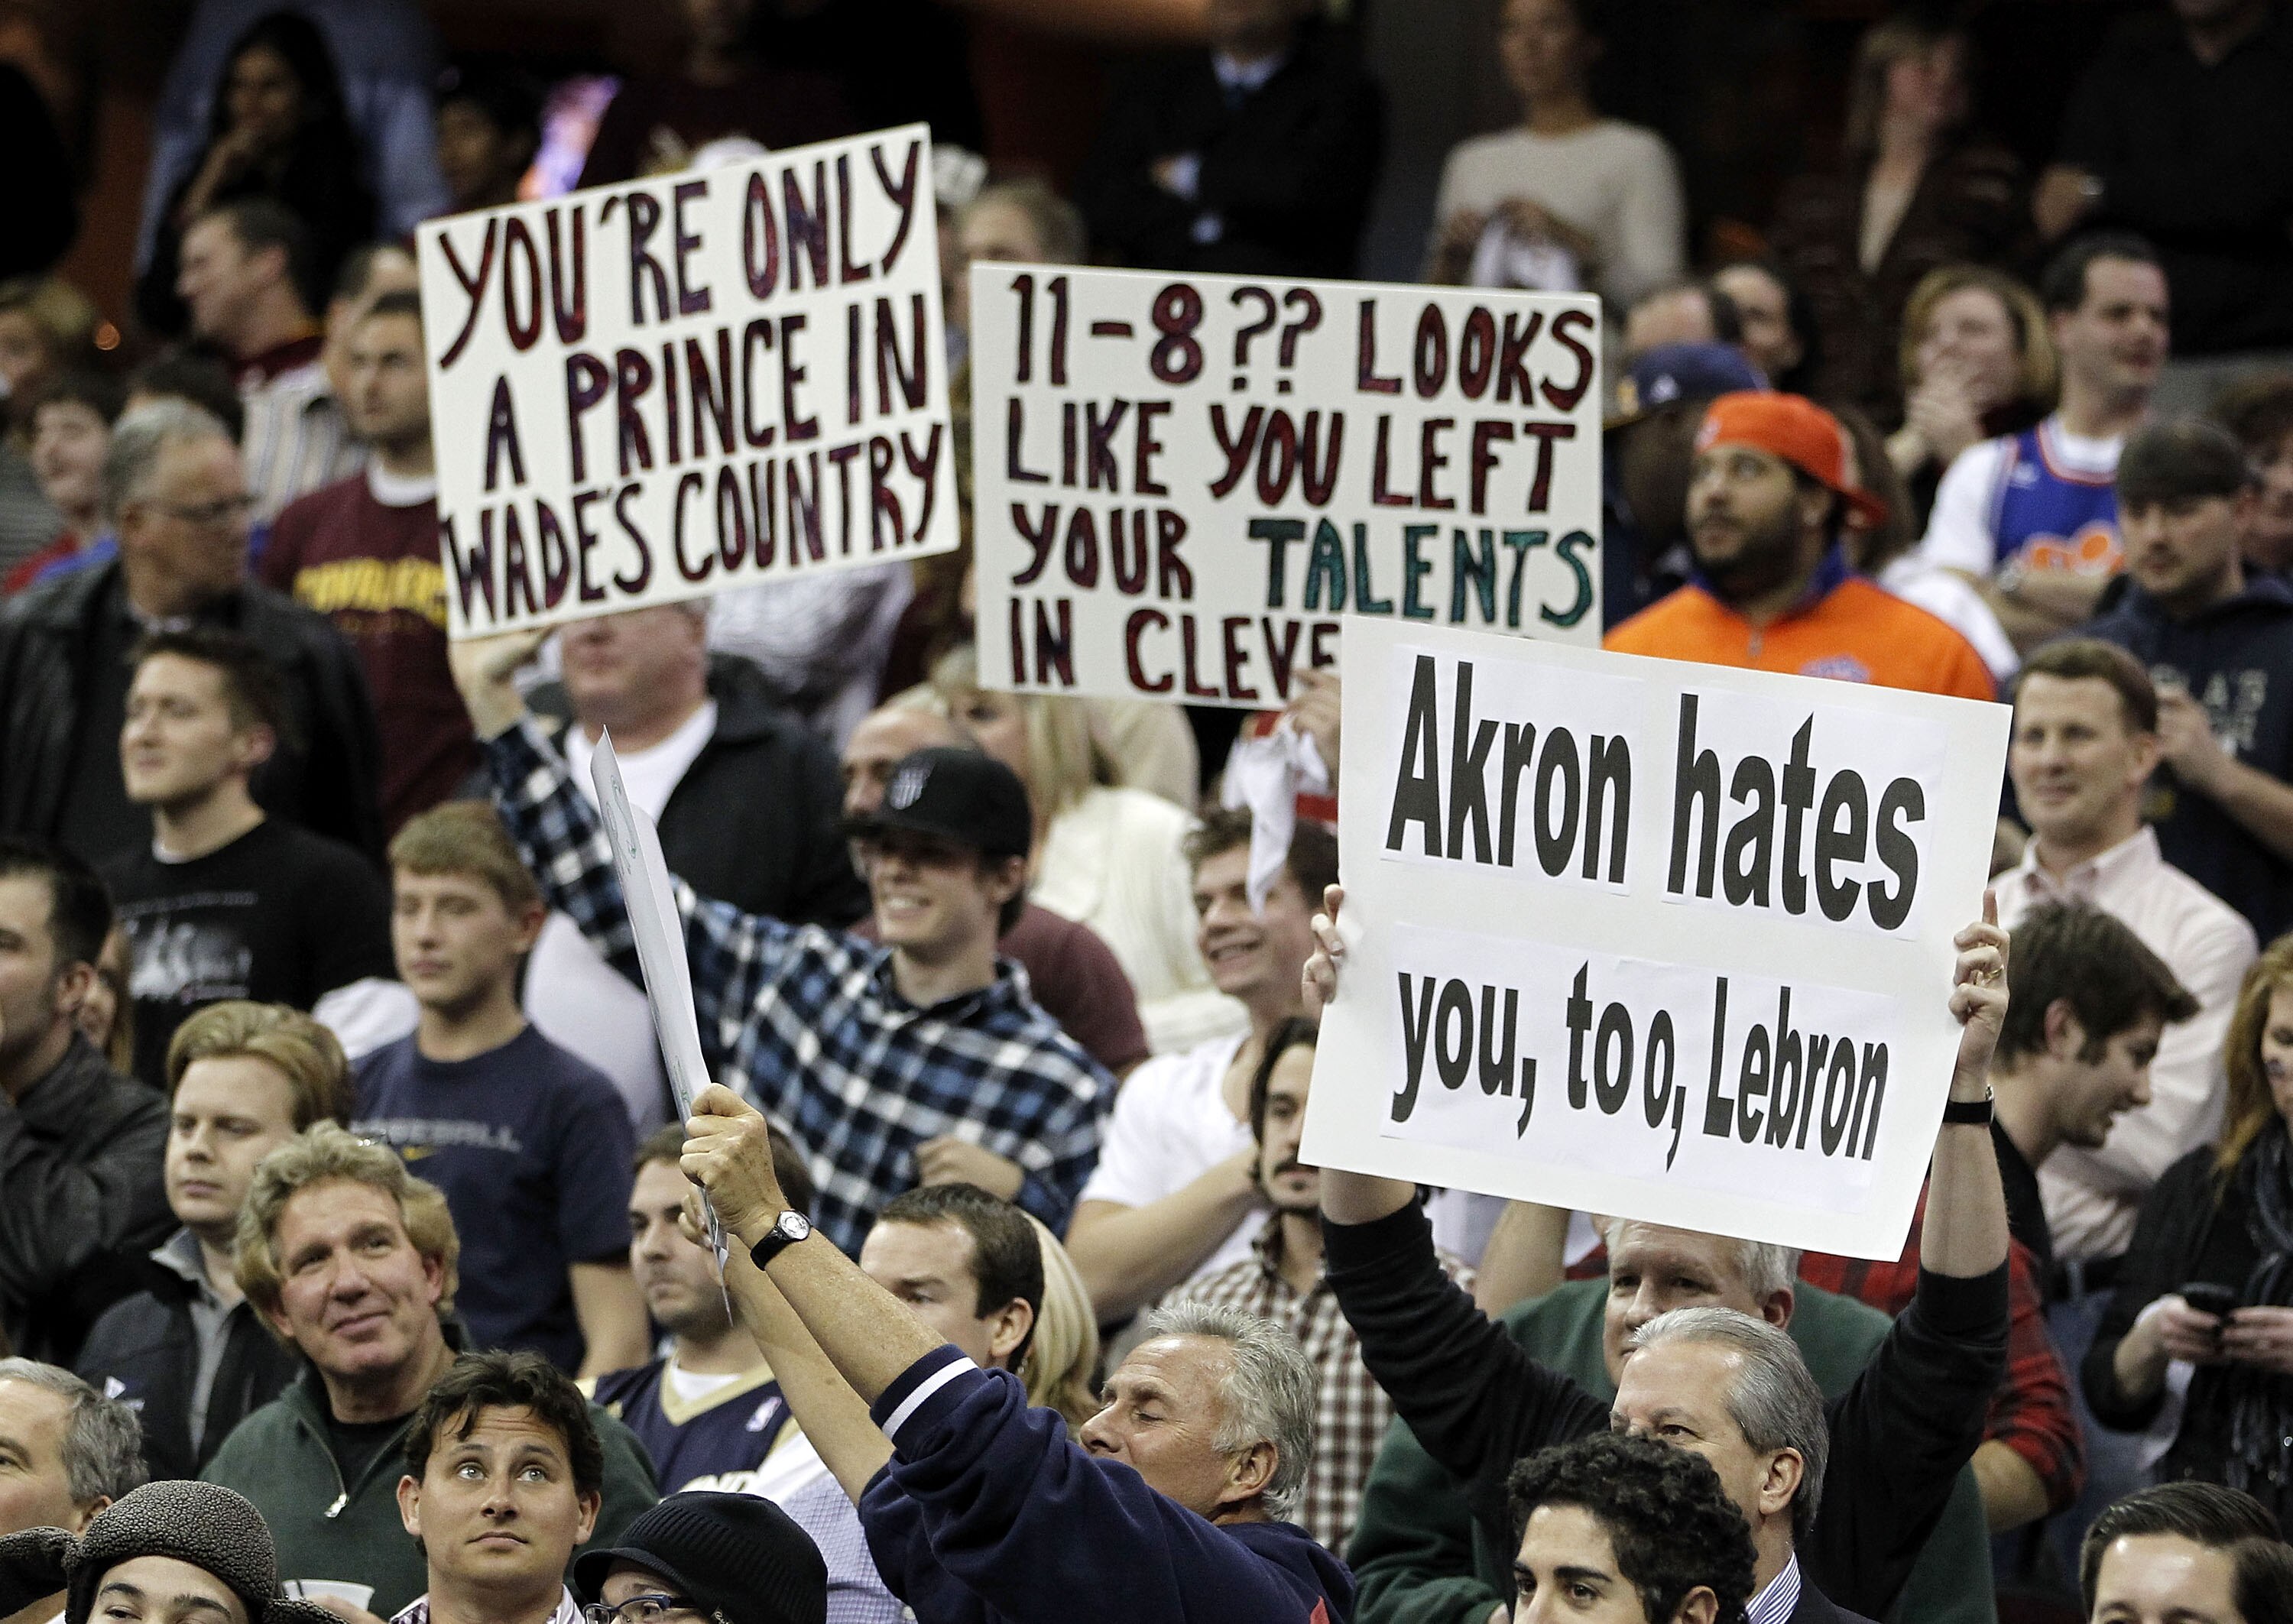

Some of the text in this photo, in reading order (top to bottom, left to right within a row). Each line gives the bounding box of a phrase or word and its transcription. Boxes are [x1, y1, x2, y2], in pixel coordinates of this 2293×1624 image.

[440, 141, 921, 368] YOU'RE ONLY
[485, 293, 928, 492] A PRINCE IN
[1357, 299, 1595, 412] LOOKS
[674, 423, 942, 582] COUNTRY
[1007, 397, 1576, 514] LIKE YOU LEFT
[1010, 503, 1595, 630] YOUR TALENTS
[1010, 598, 1073, 688] IN
[1386, 654, 1925, 931] Akron hates
[1390, 971, 1538, 1141] you,
[1703, 977, 1889, 1162] Lebron
